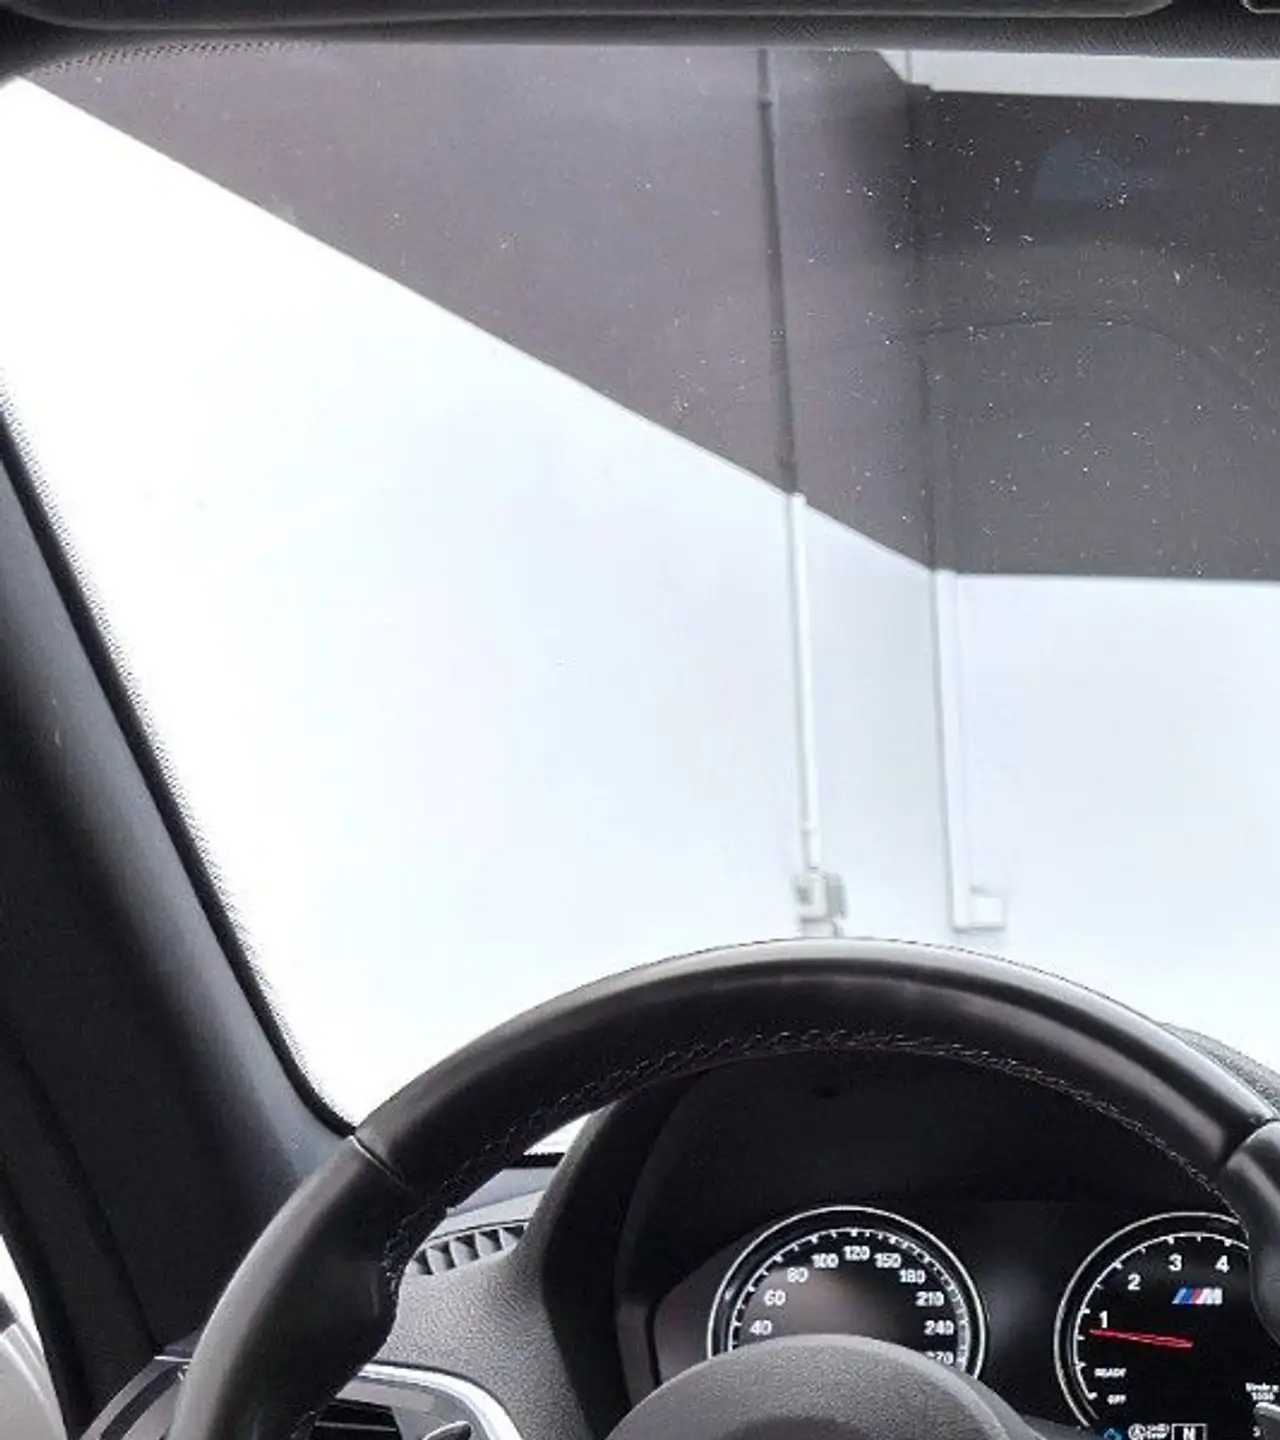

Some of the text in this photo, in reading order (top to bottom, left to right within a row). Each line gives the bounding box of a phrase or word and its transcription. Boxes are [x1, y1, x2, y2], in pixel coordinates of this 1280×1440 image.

[811, 1253, 839, 1268] 100
[843, 1246, 871, 1262] 120
[874, 1253, 901, 1268] 150
[1167, 1253, 1182, 1272] 3
[1214, 1254, 1230, 1273] 4
[787, 1267, 809, 1283] 80
[900, 1269, 926, 1284] 180
[1127, 1274, 1142, 1291] 2
[764, 1289, 787, 1306] 60
[915, 1291, 945, 1307] 210
[1099, 1310, 1109, 1329] 1
[750, 1320, 772, 1336] 40
[923, 1320, 954, 1336] 240
[1182, 1426, 1197, 1440] N
